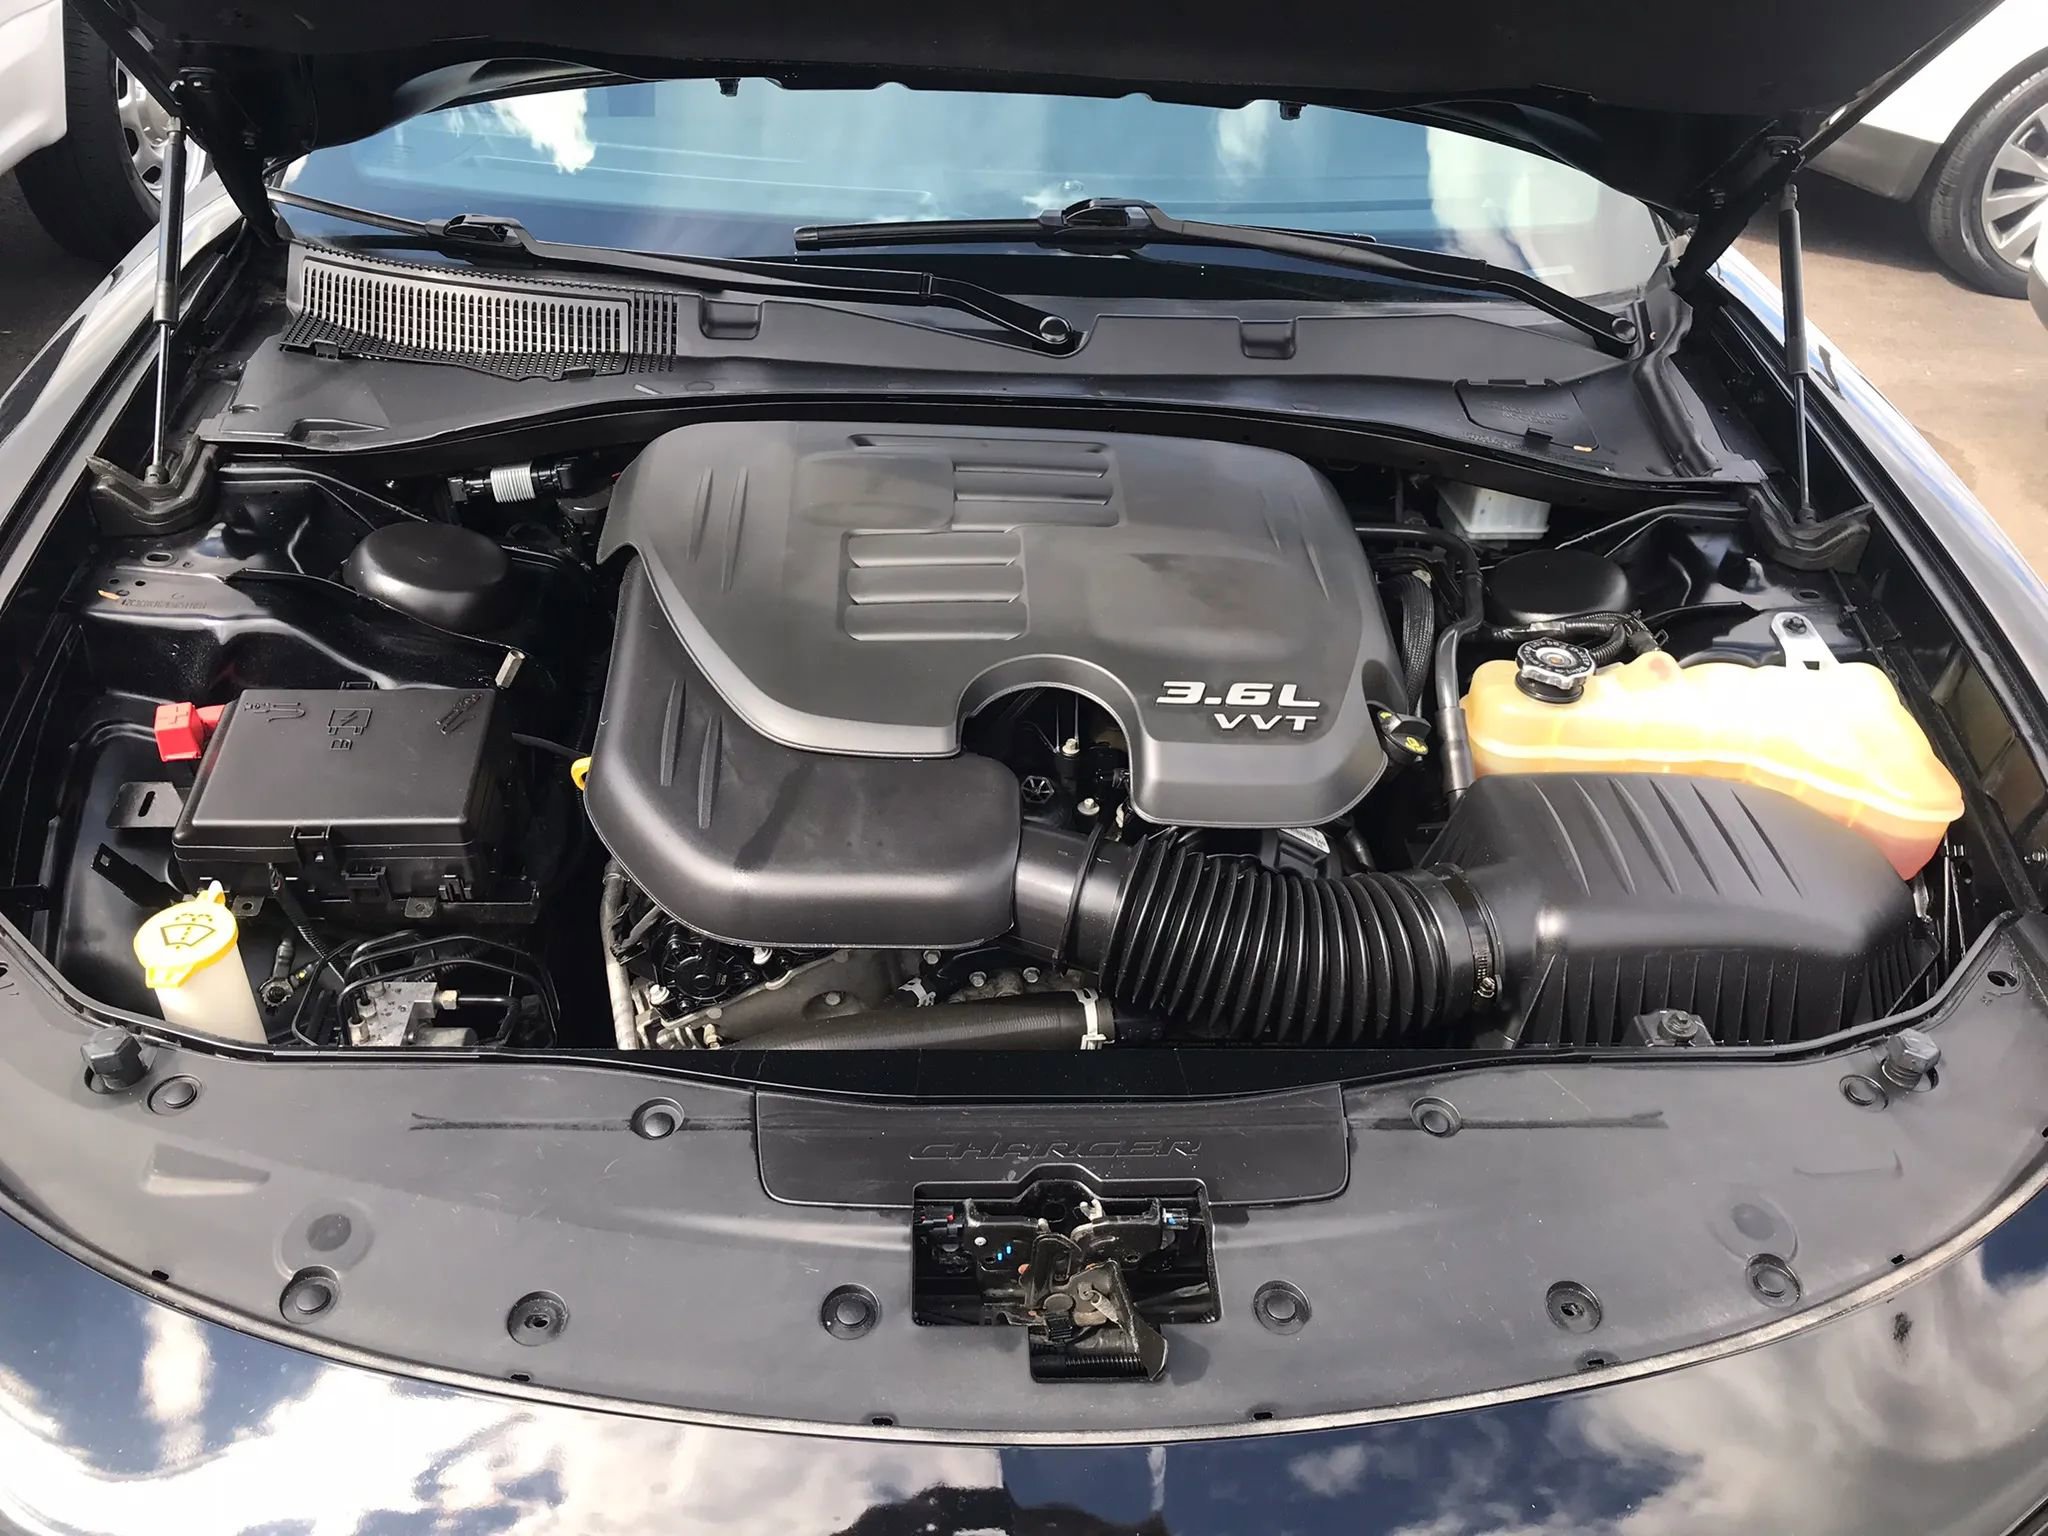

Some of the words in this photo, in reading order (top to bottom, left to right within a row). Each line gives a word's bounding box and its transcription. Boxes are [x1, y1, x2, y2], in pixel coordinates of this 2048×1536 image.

[1156, 681, 1320, 707] 3.6L
[1214, 713, 1317, 731] VVT
[908, 1140, 1202, 1160] CHARGER
